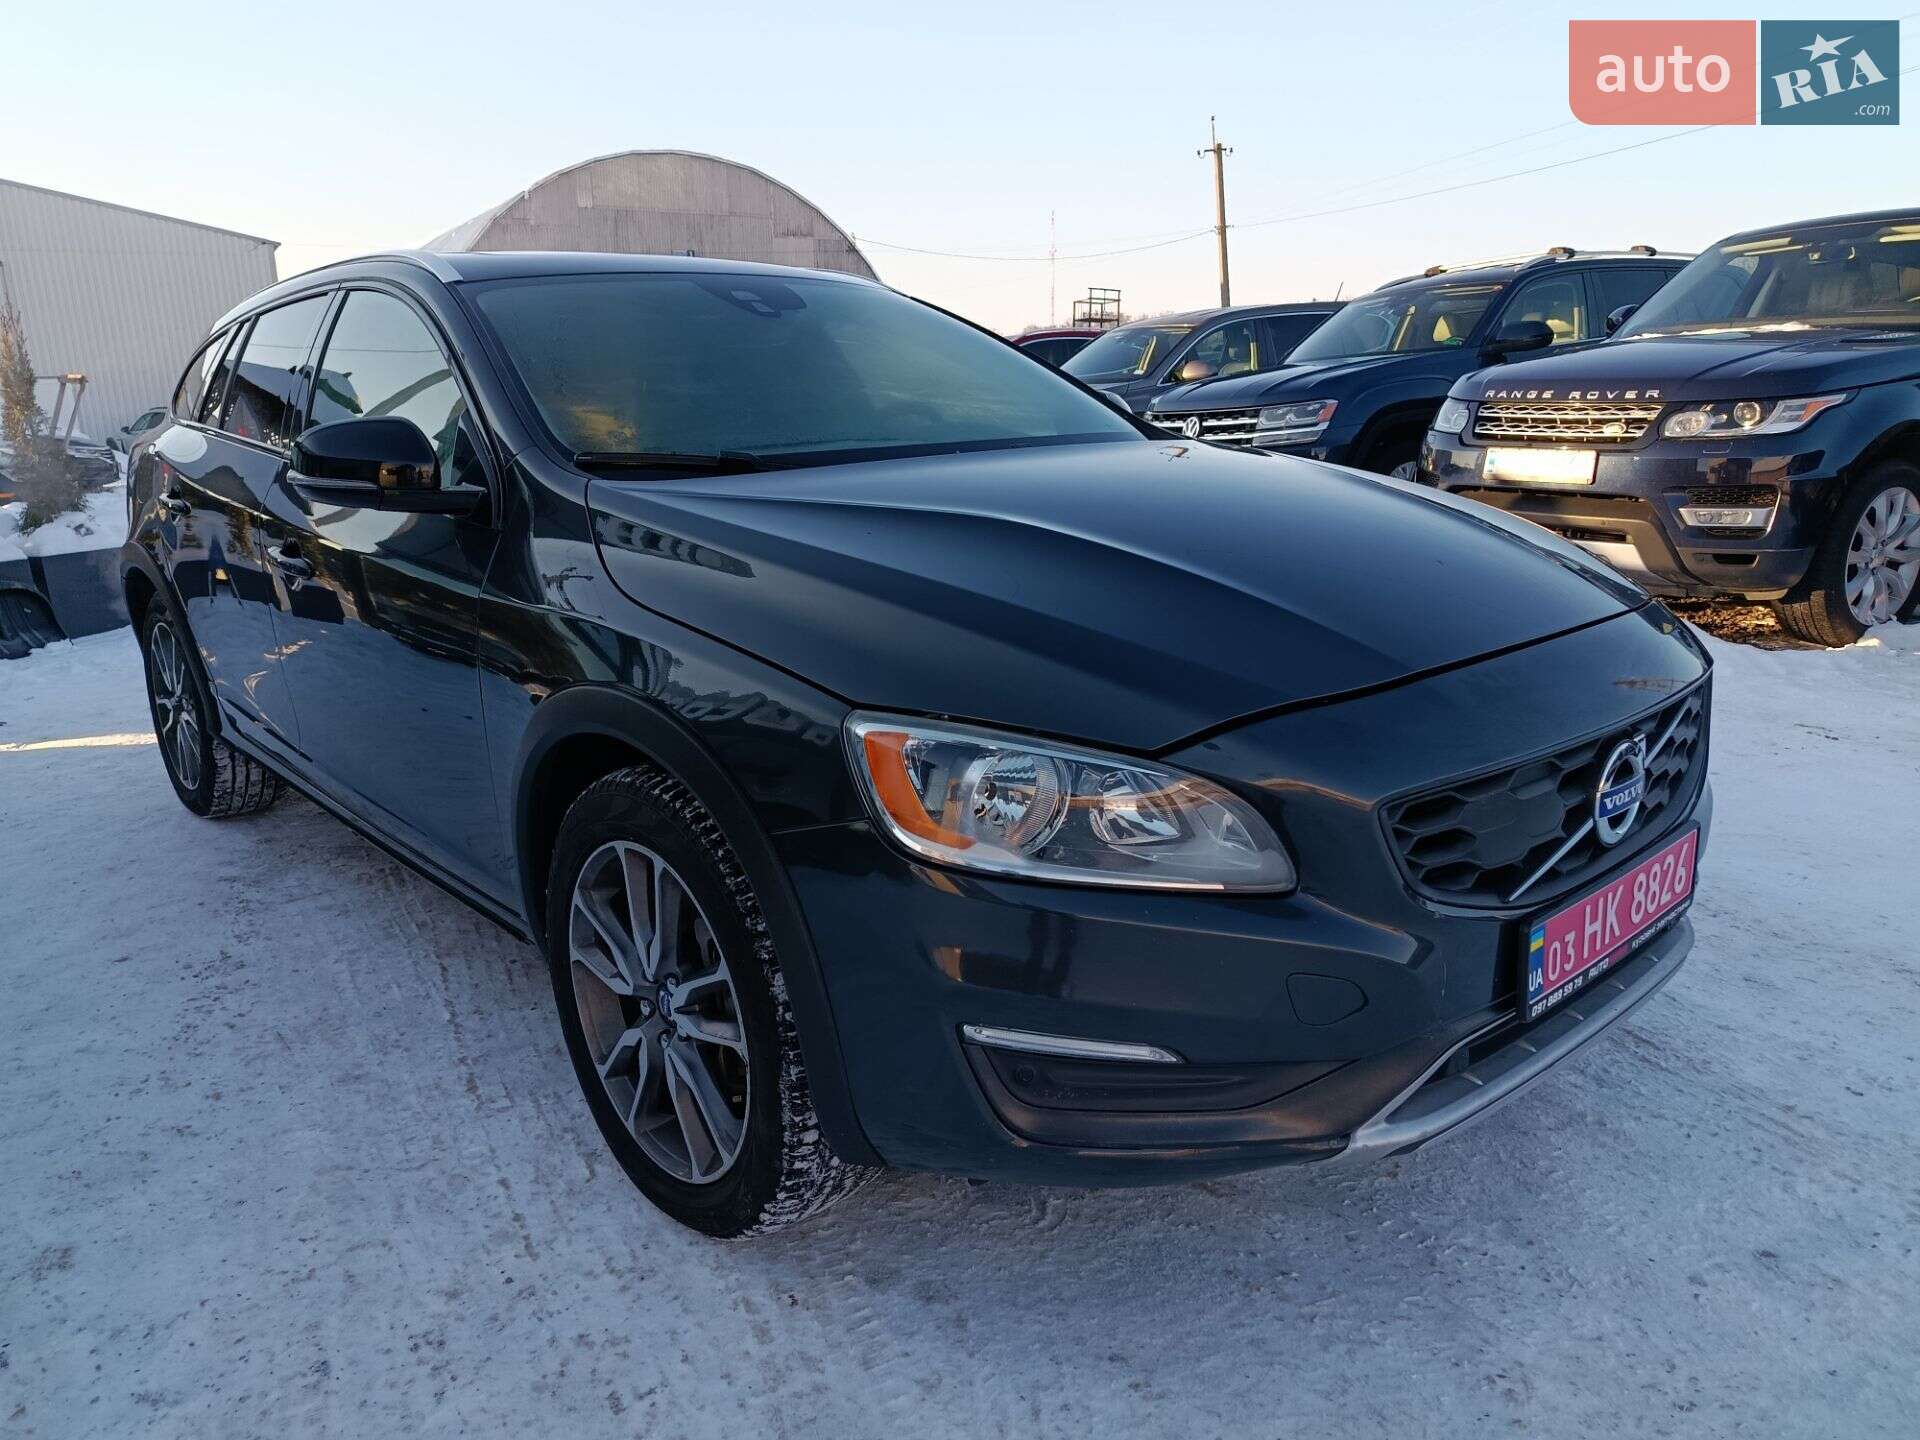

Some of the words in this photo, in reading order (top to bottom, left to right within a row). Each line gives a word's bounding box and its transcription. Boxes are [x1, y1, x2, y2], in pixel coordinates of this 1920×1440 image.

[1485, 390, 1554, 399] RANGE
[1568, 389, 1660, 400] ROVER
[1548, 930, 1576, 981] 03
[1630, 843, 1688, 924] 8826
[1528, 967, 1543, 992] UA
